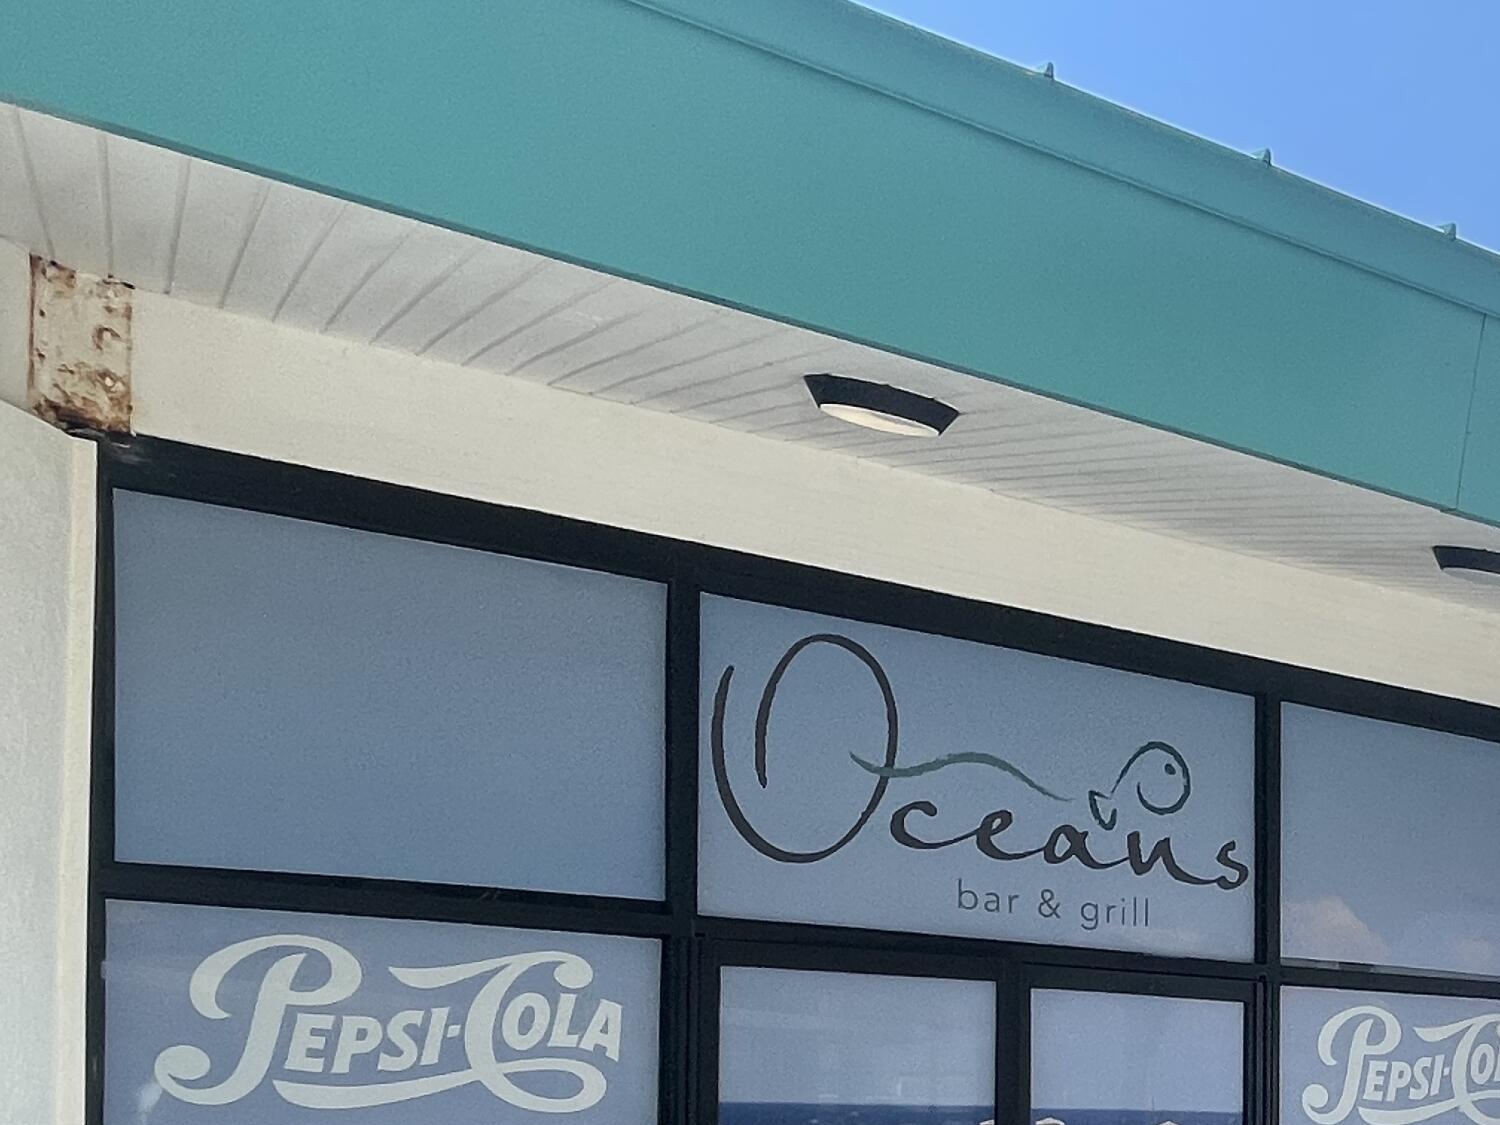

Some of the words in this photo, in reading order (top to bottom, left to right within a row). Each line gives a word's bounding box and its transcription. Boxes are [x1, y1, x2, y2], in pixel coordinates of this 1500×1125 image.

[711, 633, 1249, 890] Oceans
[957, 878, 1019, 914] bar
[1037, 888, 1062, 919] &
[1080, 896, 1150, 931] grill
